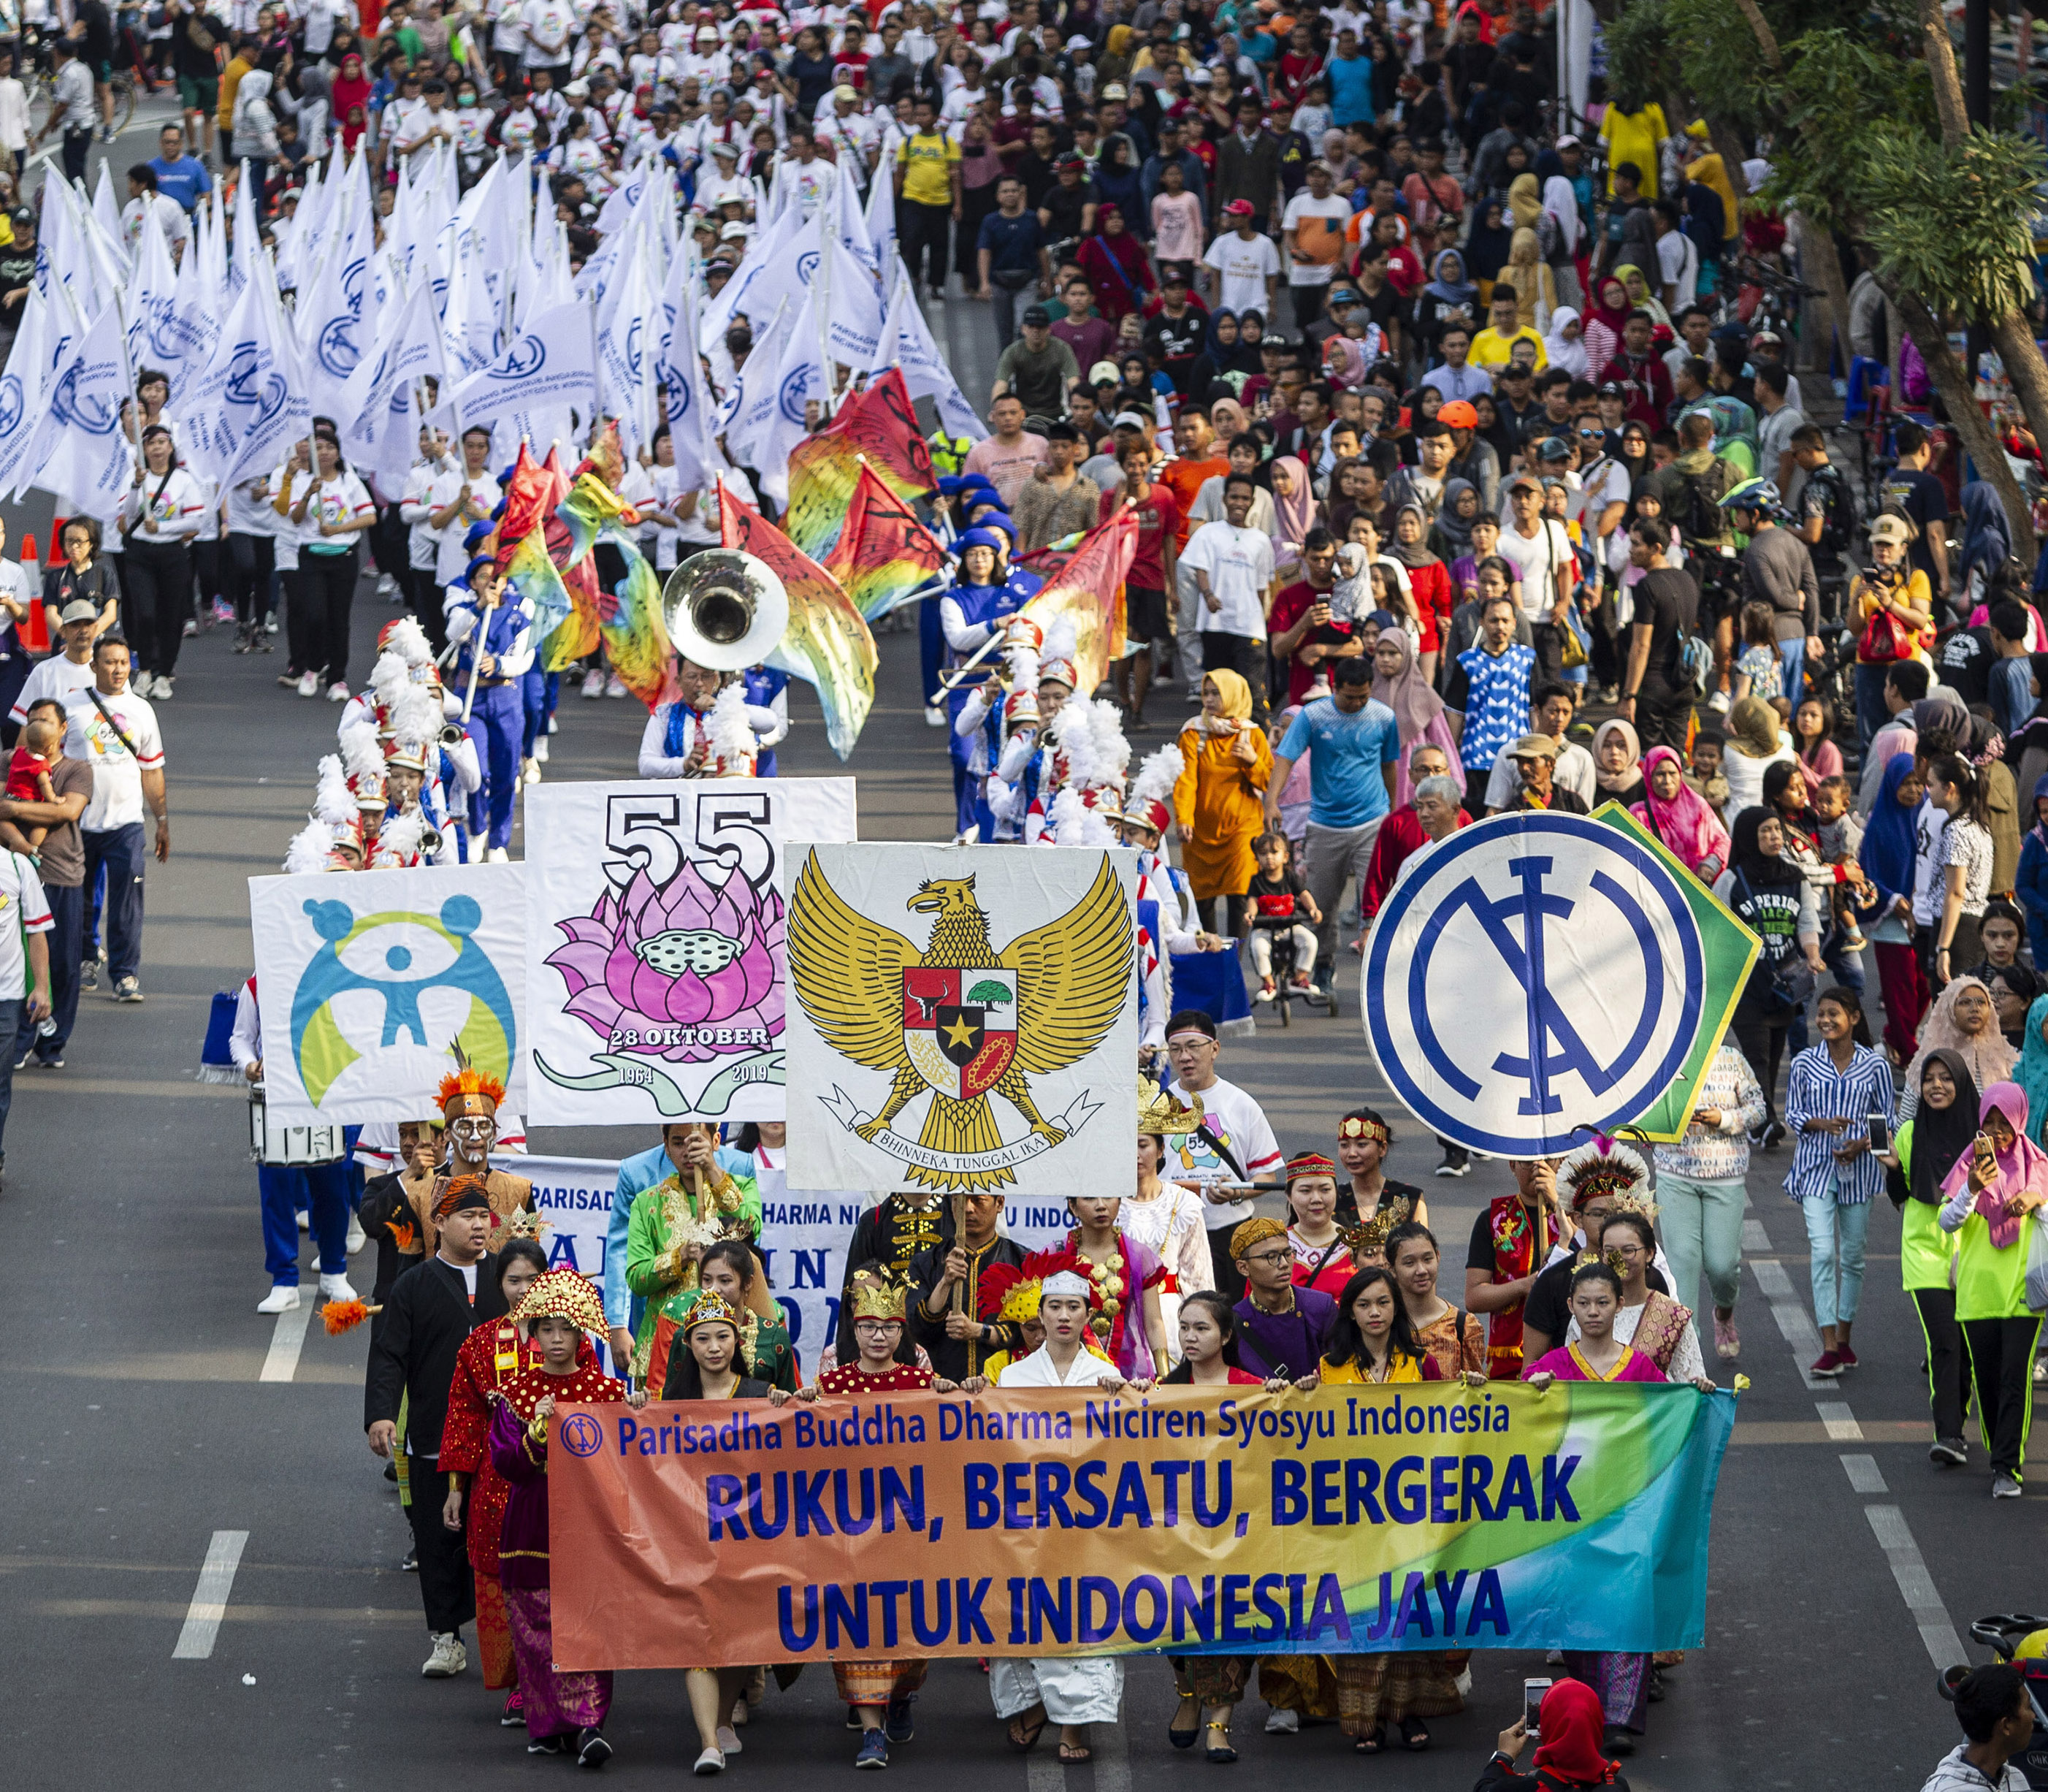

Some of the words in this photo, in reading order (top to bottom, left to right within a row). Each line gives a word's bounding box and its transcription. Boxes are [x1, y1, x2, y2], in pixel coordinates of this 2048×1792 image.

[601, 793, 775, 891] 55
[610, 1029, 638, 1047] 28
[645, 1027, 771, 1046] OKTOBER
[618, 1066, 654, 1085] 1964
[732, 1064, 768, 1083] 2019
[879, 1134, 949, 1169] BHINNEKA
[954, 1151, 1019, 1170] TUNGGAL
[1020, 1137, 1045, 1158] IKA
[619, 1411, 782, 1456] Parisadha
[795, 1404, 925, 1449] Buddha
[939, 1398, 1072, 1442] Dharma
[1086, 1398, 1206, 1439] Niciren
[1220, 1400, 1335, 1449] Syosyu
[1348, 1394, 1510, 1436] Indonesia
[707, 1465, 944, 1543] RUKUN,
[965, 1460, 1250, 1539] BERSATU,
[1272, 1454, 1582, 1527] BERGERAK
[779, 1577, 996, 1652] UNTUK
[1008, 1572, 1353, 1645] INDONESIA
[1367, 1569, 1512, 1641] JAYA
